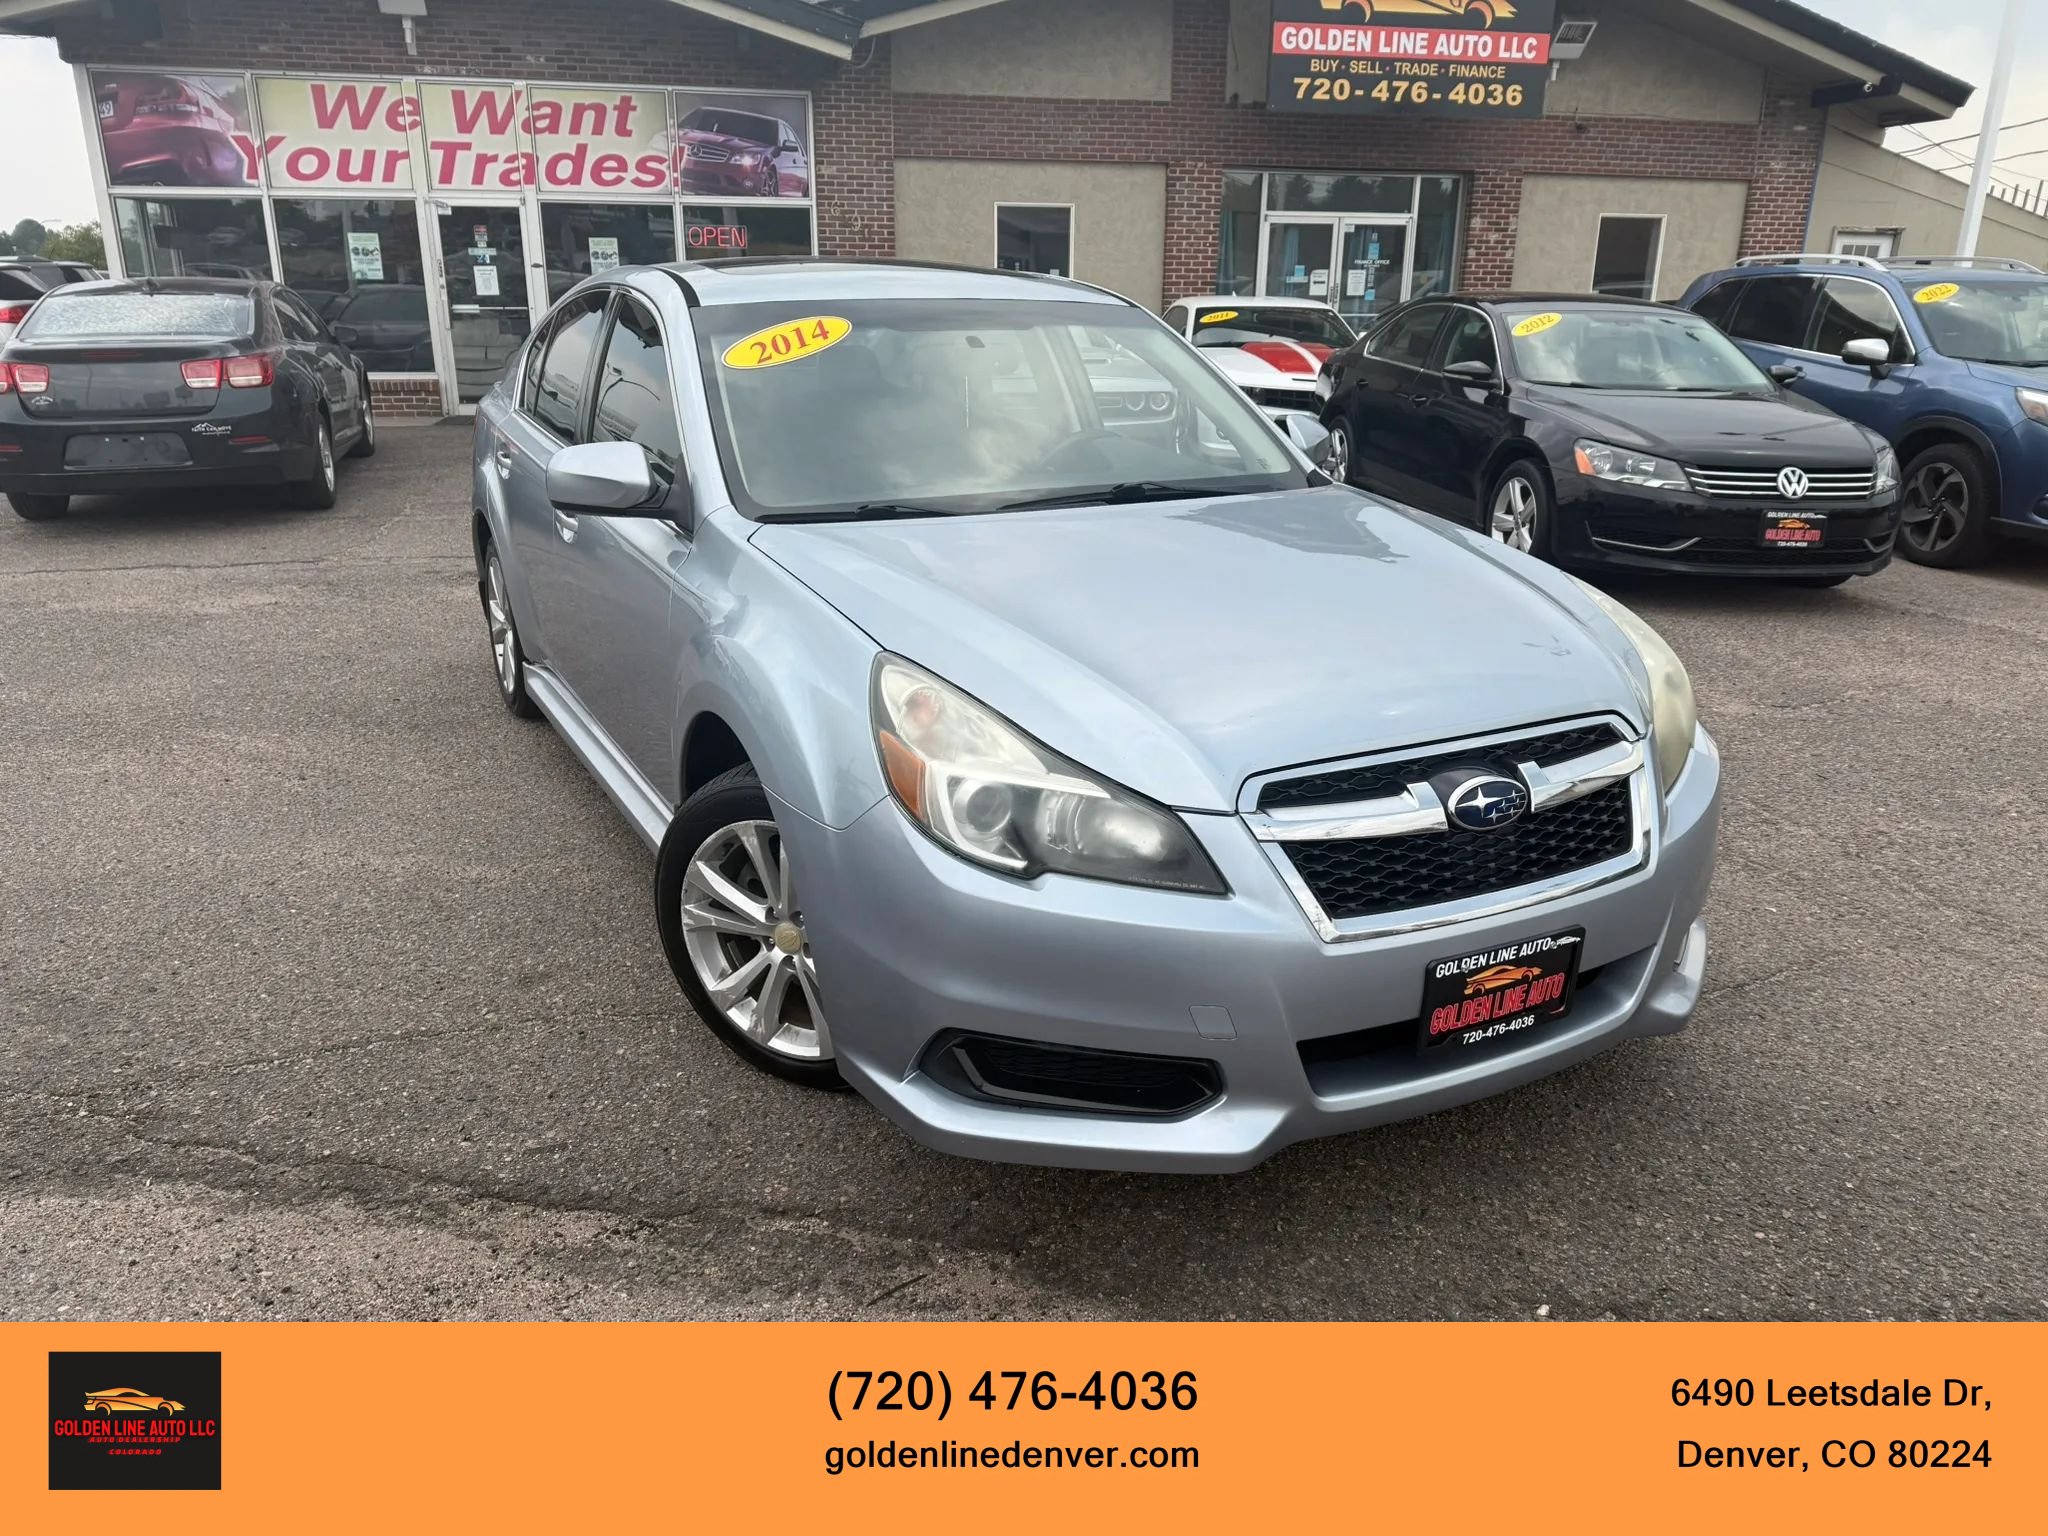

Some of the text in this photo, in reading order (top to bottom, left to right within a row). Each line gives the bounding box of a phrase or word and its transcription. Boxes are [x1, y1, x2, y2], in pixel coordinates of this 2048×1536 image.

[1280, 26, 1538, 59] GOLDEN LINE AUTO LLC
[1310, 59, 1506, 79] BUY SELL TRADE FINANCE
[310, 83, 638, 138] We Want
[231, 134, 689, 188] Your Trades!
[687, 226, 746, 248] OPEN
[1921, 285, 1952, 301] 2022
[1521, 314, 1555, 333] 2012
[749, 319, 830, 365] 2014
[1435, 937, 1552, 979] GOLDEN LINE AUTO
[1429, 972, 1565, 1036] GOLDEN LINE AUTO
[1463, 1014, 1535, 1045] 720-476-4036
